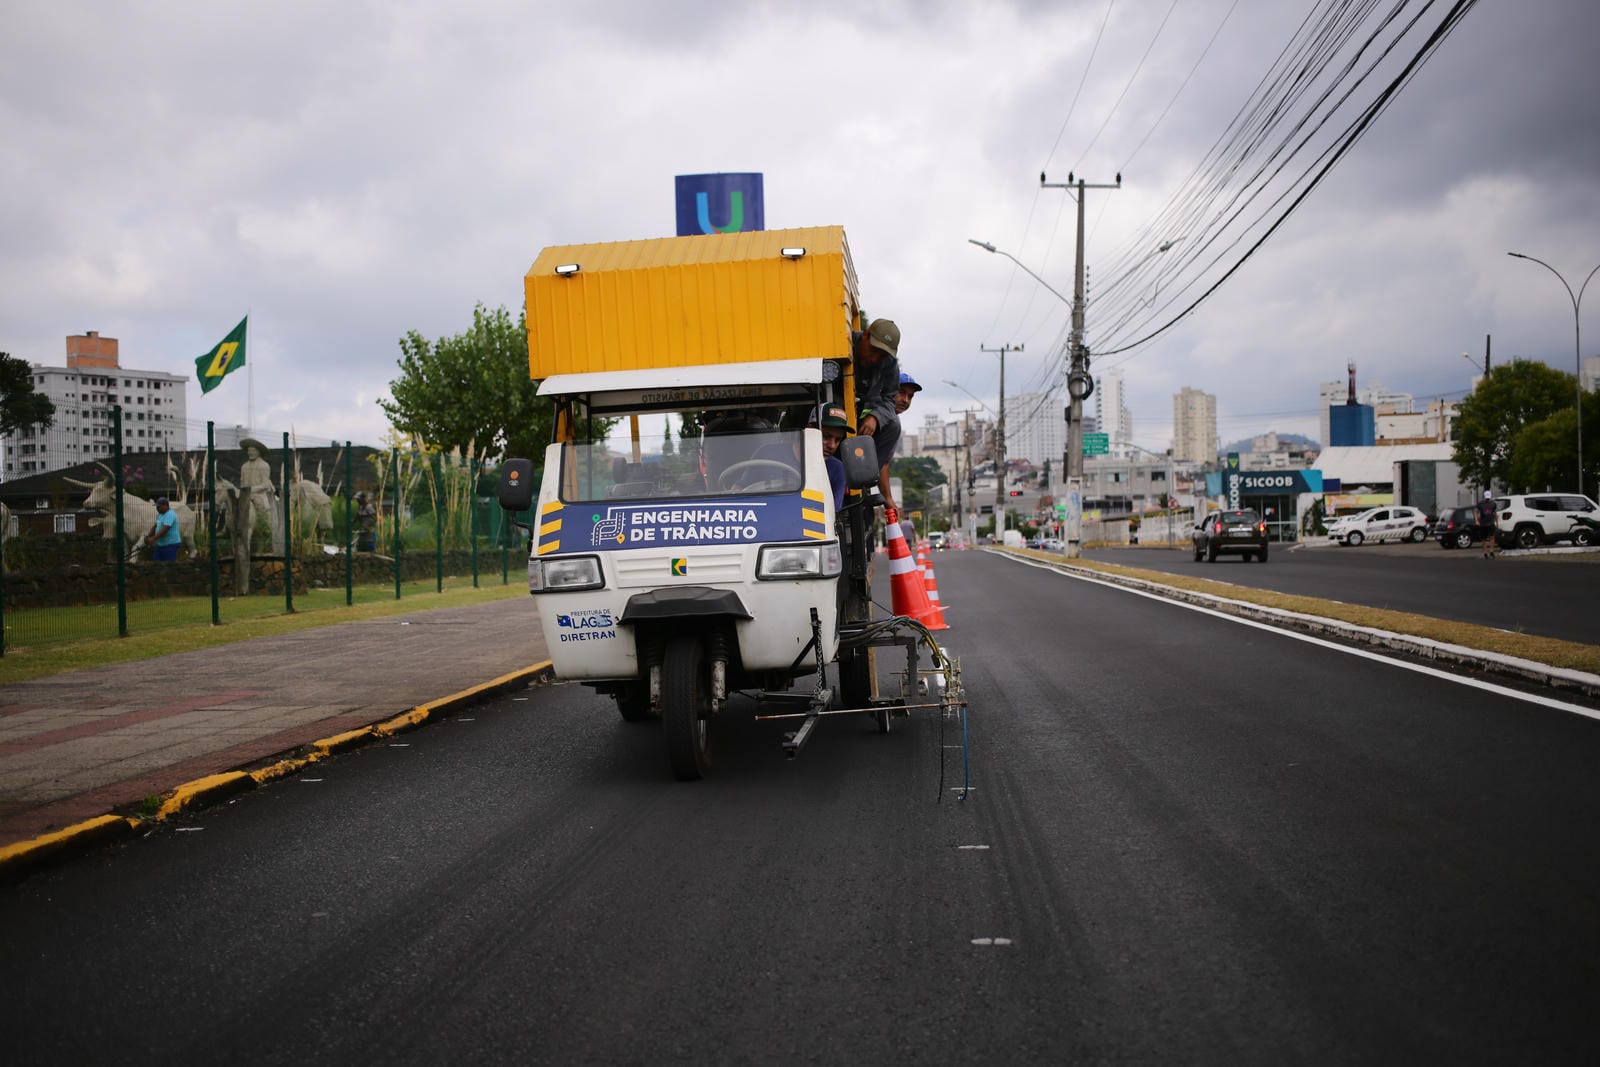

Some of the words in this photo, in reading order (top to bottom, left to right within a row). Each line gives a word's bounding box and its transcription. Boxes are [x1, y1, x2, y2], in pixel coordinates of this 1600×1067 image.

[1245, 476, 1293, 488] SICOOB
[631, 509, 758, 525] ENGENHARIA
[630, 528, 656, 541] DE
[660, 523, 758, 540] TRÂNSITO
[560, 630, 616, 642] DIRETRAN
